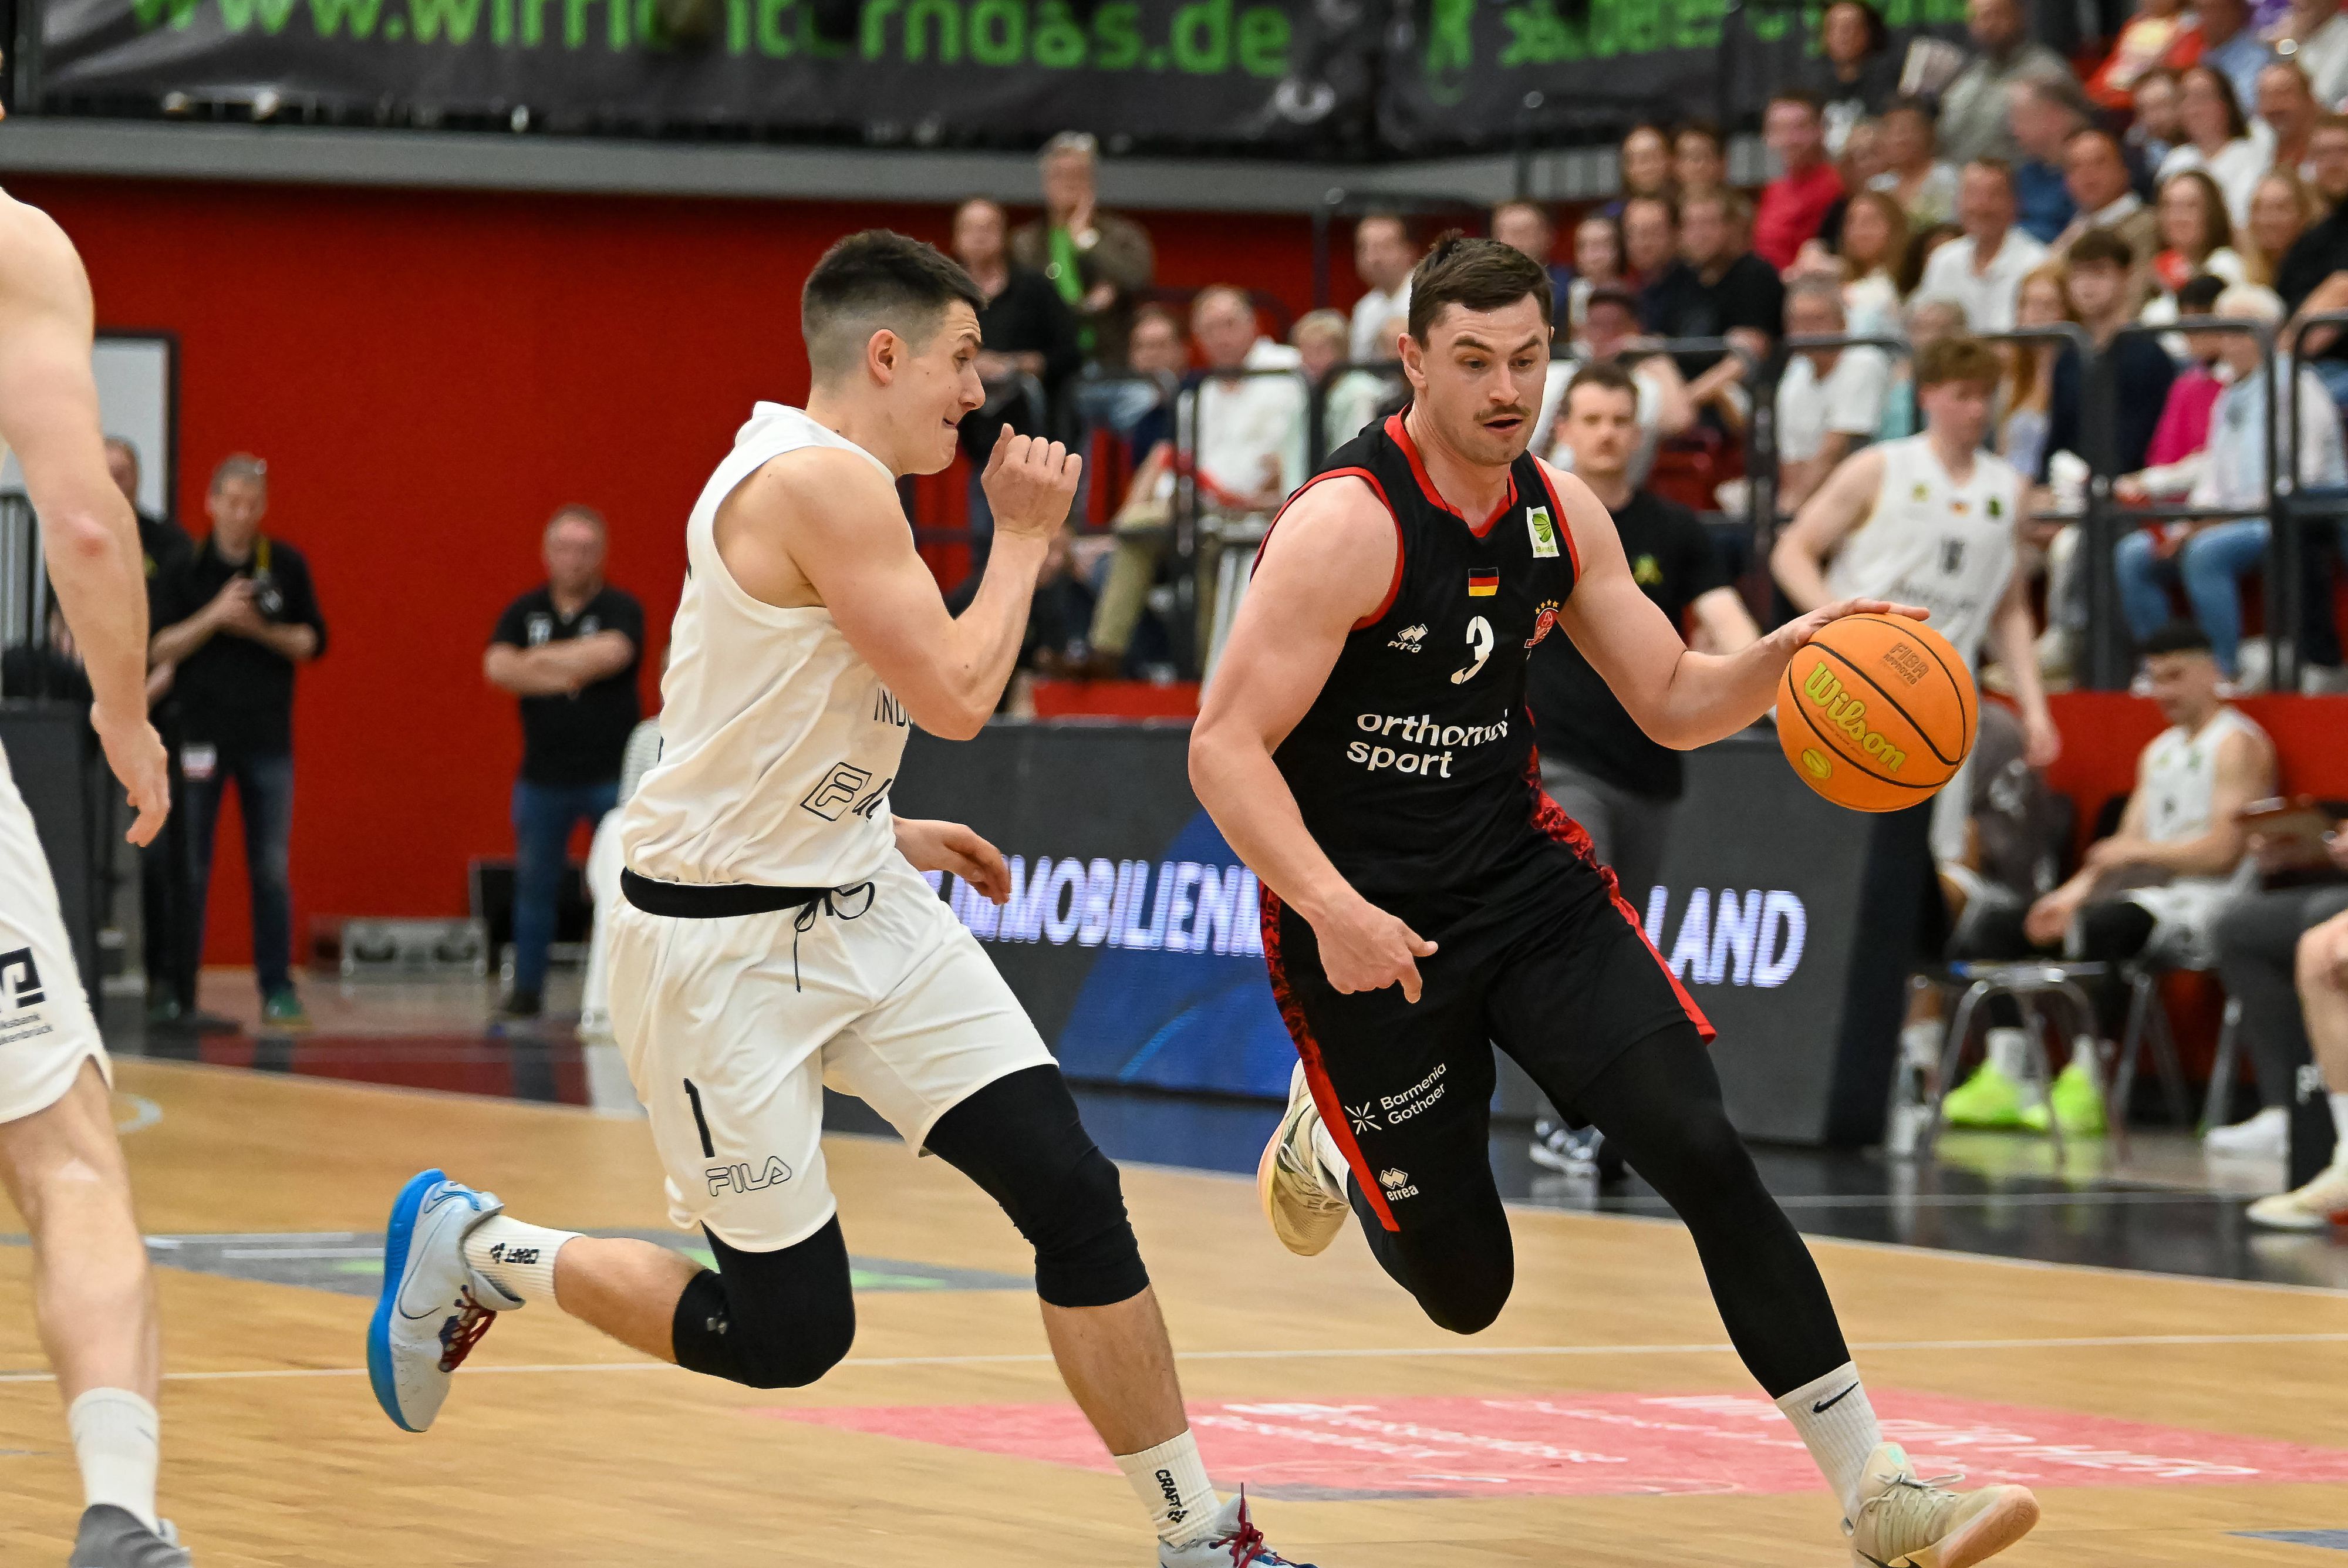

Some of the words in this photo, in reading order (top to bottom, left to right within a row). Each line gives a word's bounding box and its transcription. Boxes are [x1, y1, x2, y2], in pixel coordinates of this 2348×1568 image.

[1450, 615, 1495, 685] 3
[1890, 642, 1929, 679] FIBA
[873, 687, 913, 728] IND
[1804, 661, 1907, 773] Wilson
[1347, 741, 1453, 778] sport
[1380, 1063, 1447, 1111] Barmenia
[1388, 1083, 1445, 1124] Gothaer
[683, 1078, 715, 1158] 1
[705, 1155, 792, 1197] FILA
[1155, 1469, 1182, 1508] CRAFT
